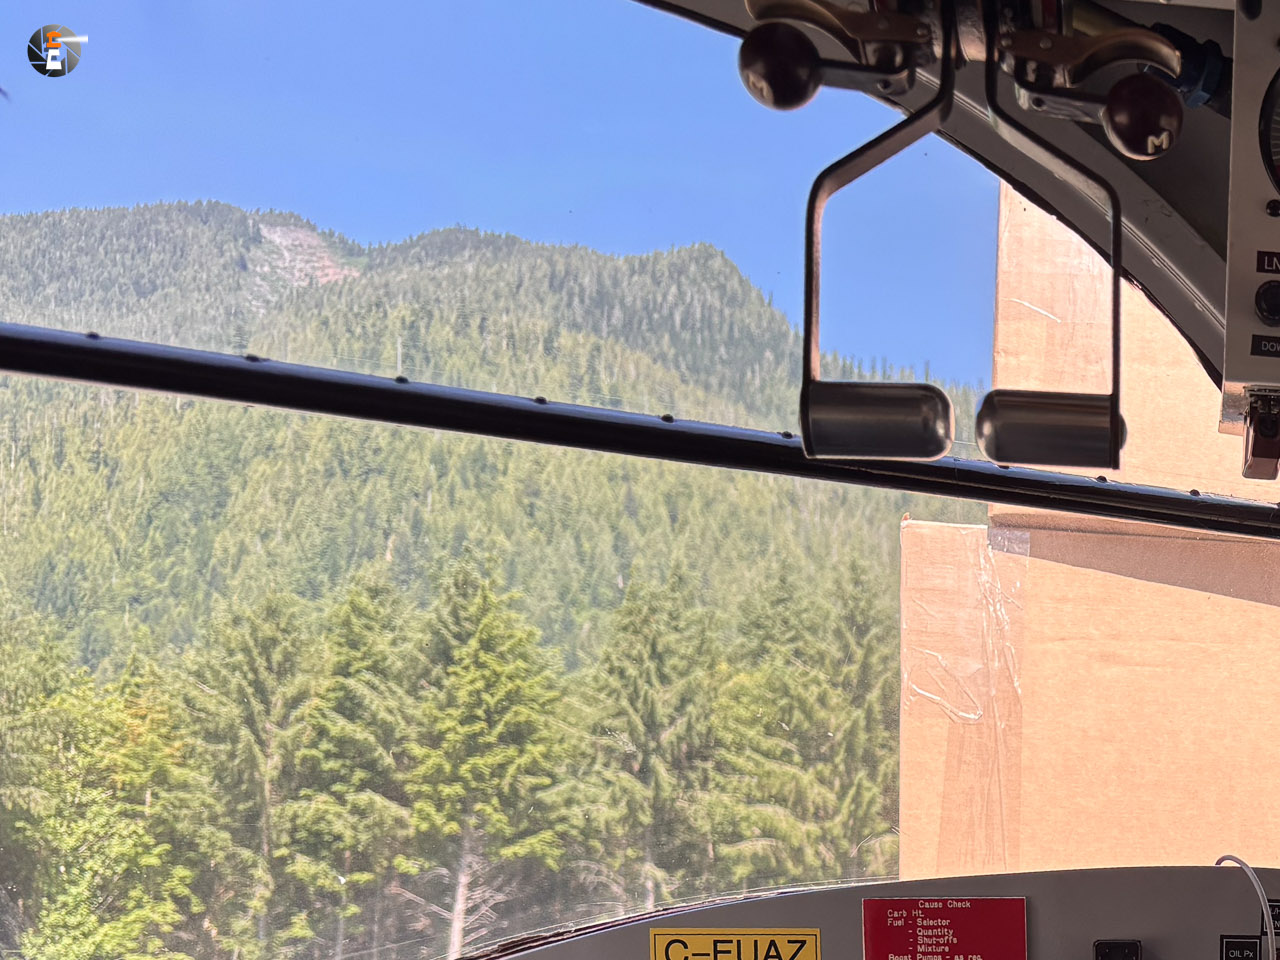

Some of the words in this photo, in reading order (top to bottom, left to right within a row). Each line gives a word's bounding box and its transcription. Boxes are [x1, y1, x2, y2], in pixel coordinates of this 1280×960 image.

[1147, 131, 1170, 153] M
[918, 900, 943, 908] Cause
[947, 900, 971, 908] Check
[887, 909, 907, 917] Carb
[917, 928, 953, 936] Quantity
[918, 936, 957, 944] Shut-offs
[1228, 950, 1242, 958] OIL
